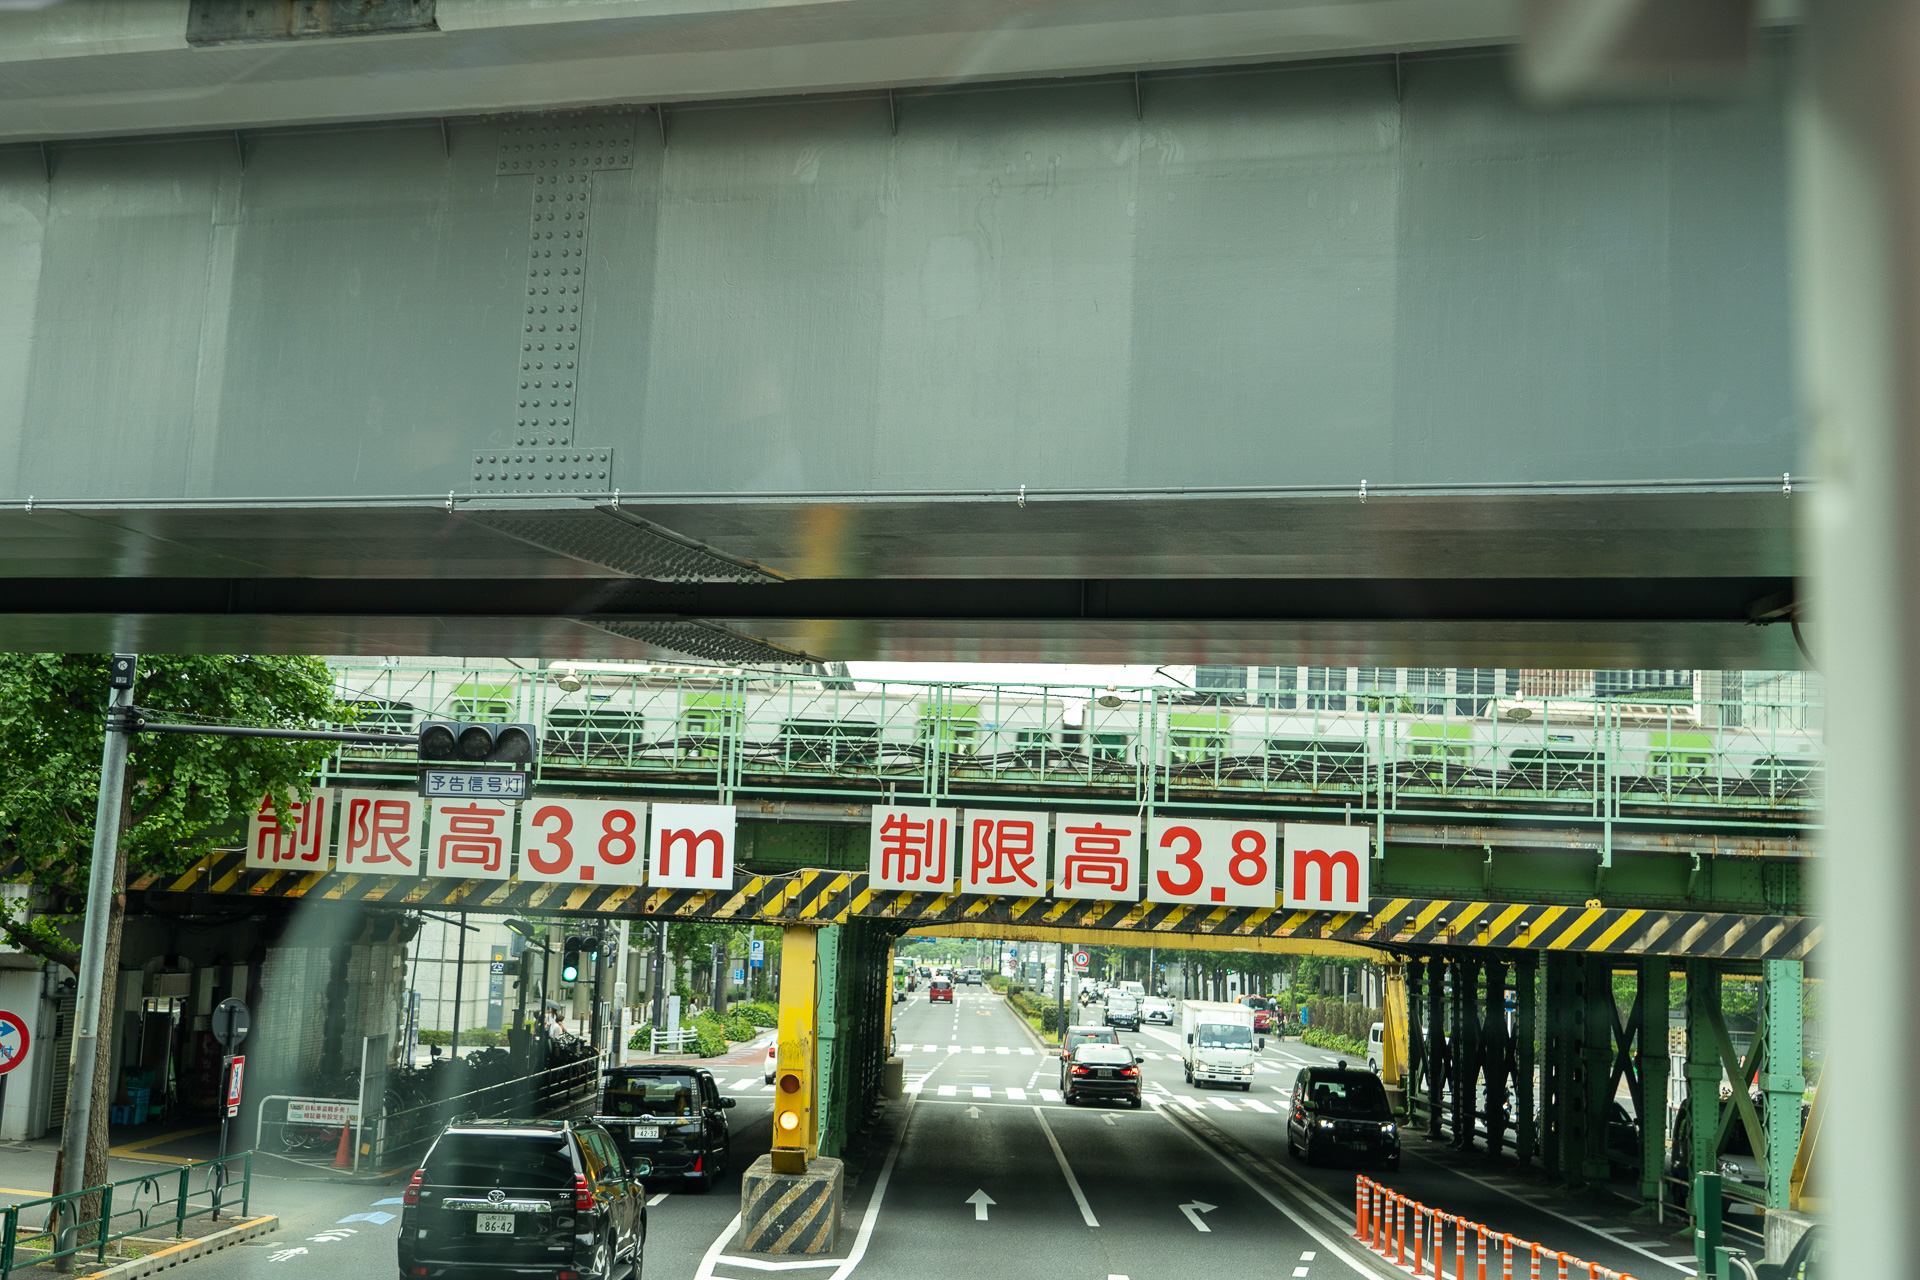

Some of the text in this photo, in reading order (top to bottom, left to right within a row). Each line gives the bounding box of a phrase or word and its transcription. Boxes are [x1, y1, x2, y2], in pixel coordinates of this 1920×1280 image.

[430, 775, 521, 793] 予告信号灯
[484, 1221, 512, 1233] 86-42
